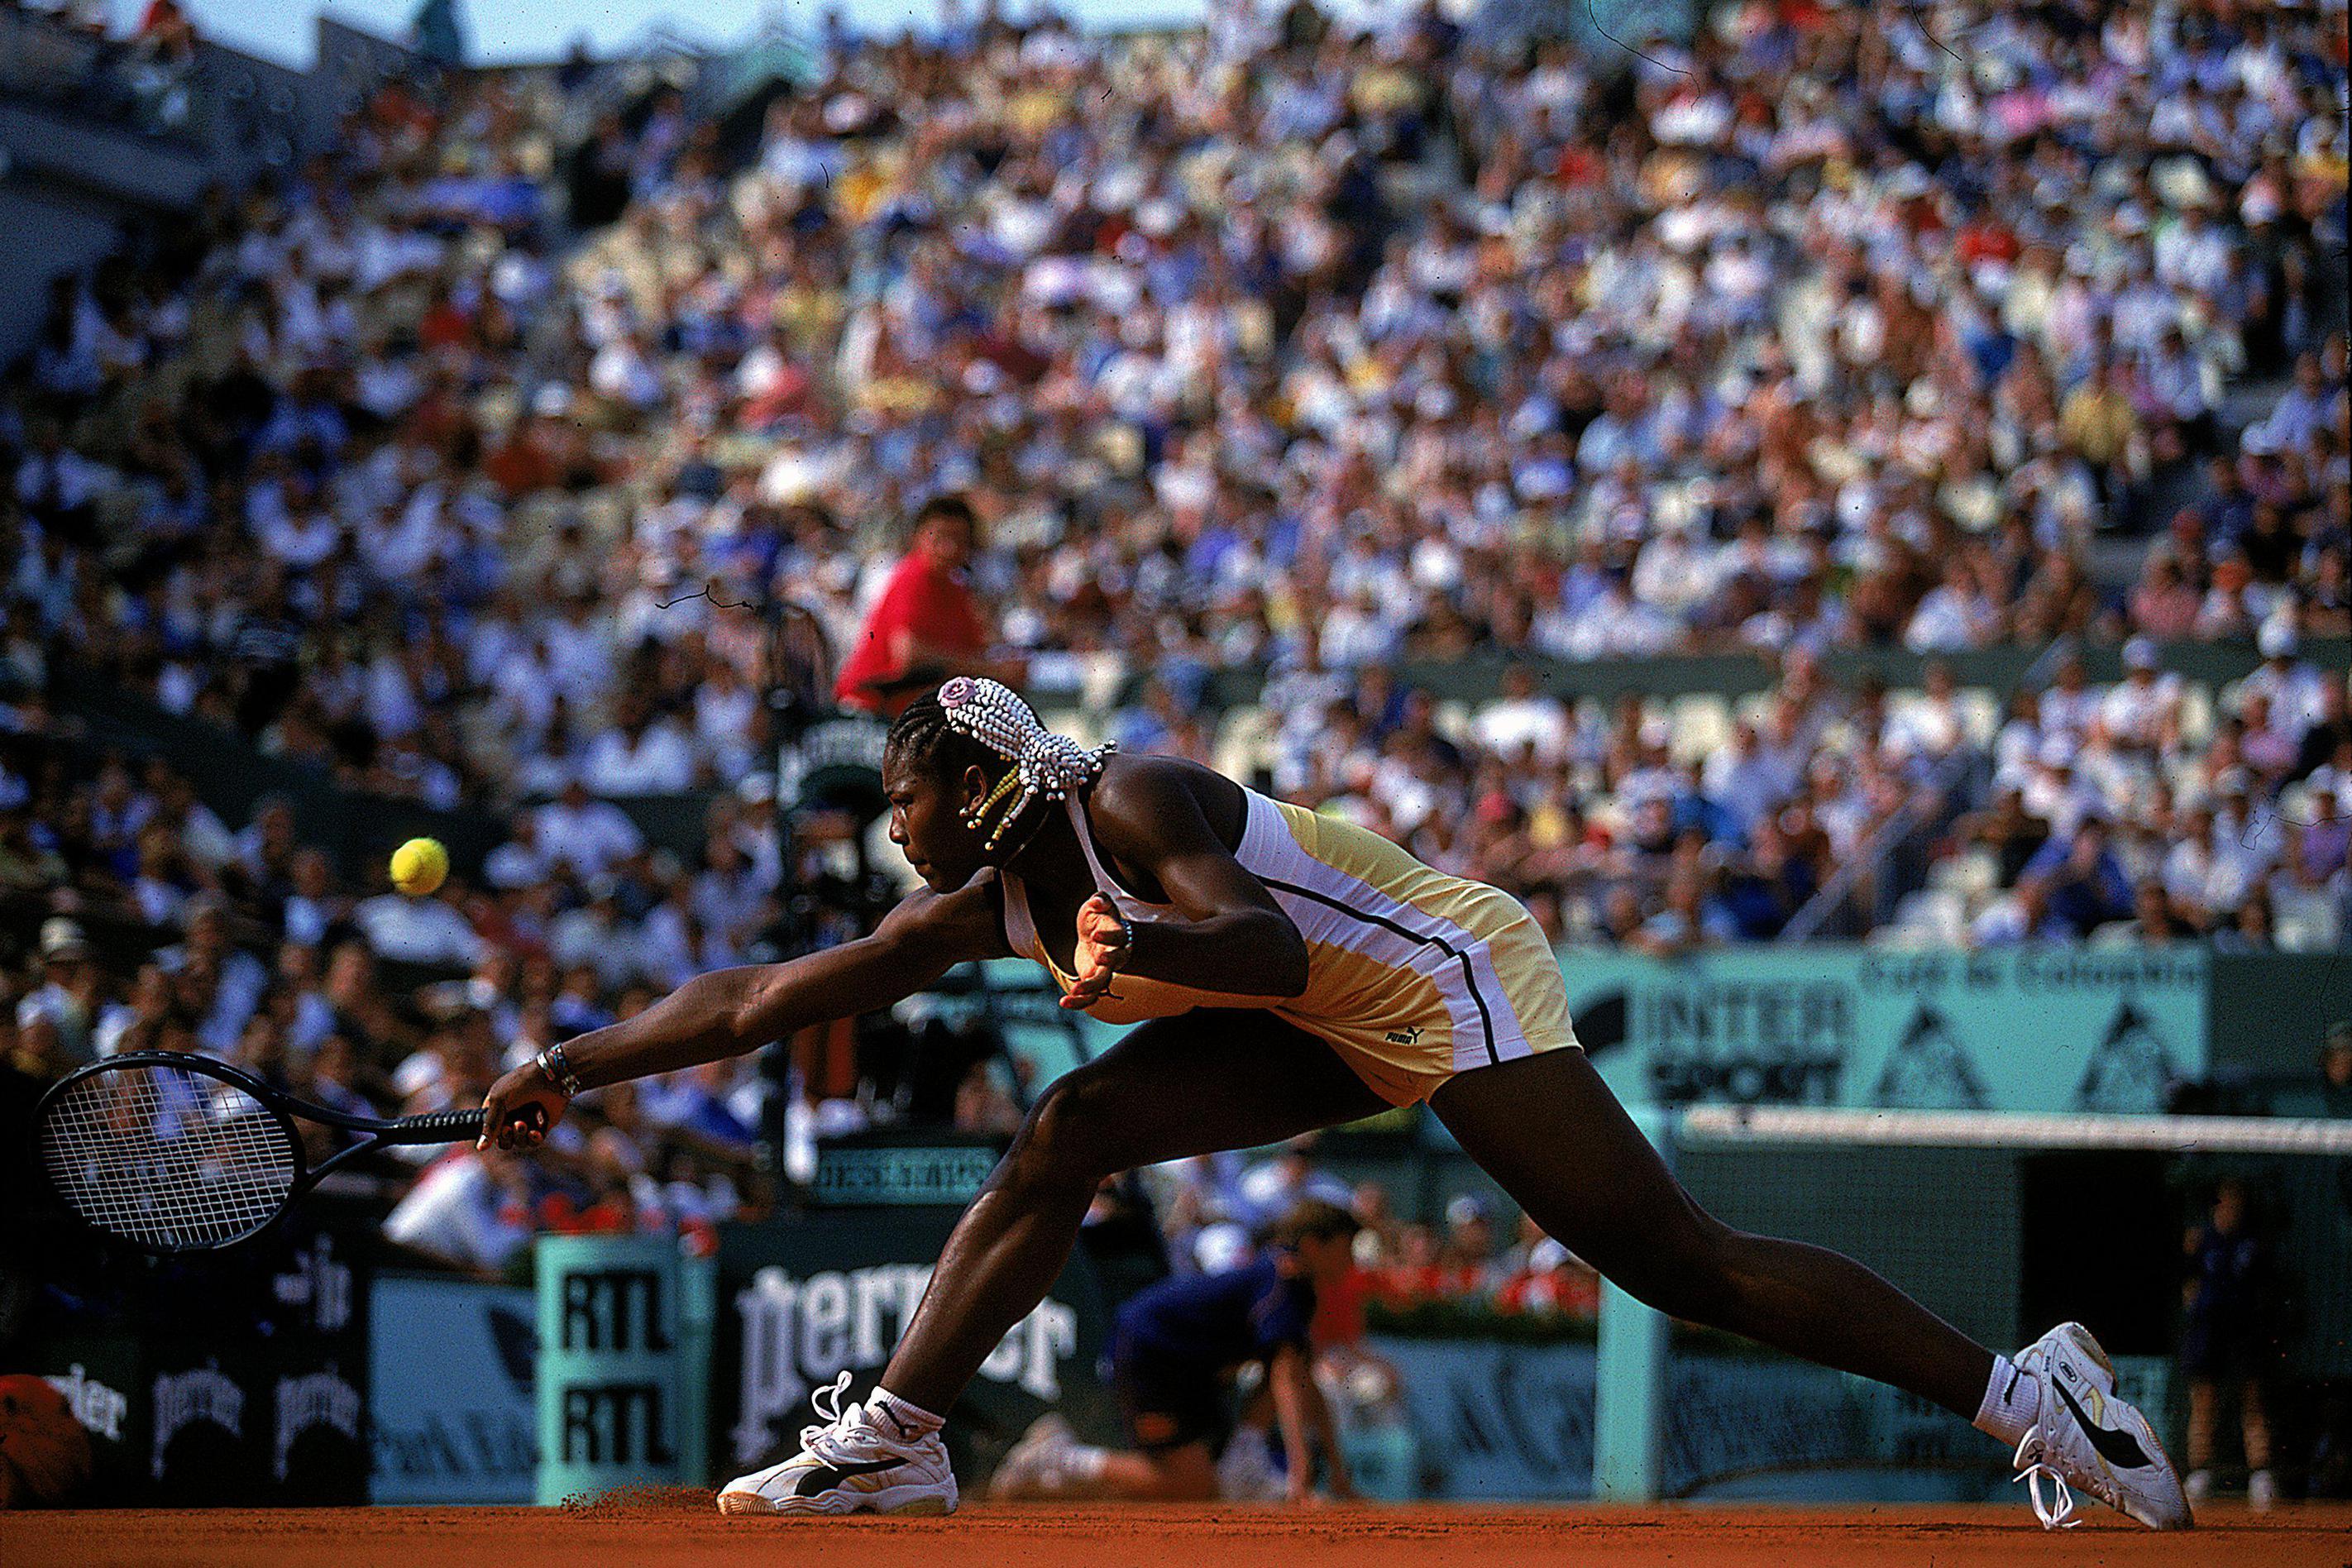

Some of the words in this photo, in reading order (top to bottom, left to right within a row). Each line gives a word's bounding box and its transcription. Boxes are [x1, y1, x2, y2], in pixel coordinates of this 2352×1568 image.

[1384, 1031, 1413, 1045] PUMA
[1644, 981, 1852, 1049] INTER
[1649, 1054, 1844, 1102] SPORT
[562, 1269, 668, 1354] RTL
[734, 1263, 1078, 1465] perrer
[562, 1384, 668, 1467] RTL
